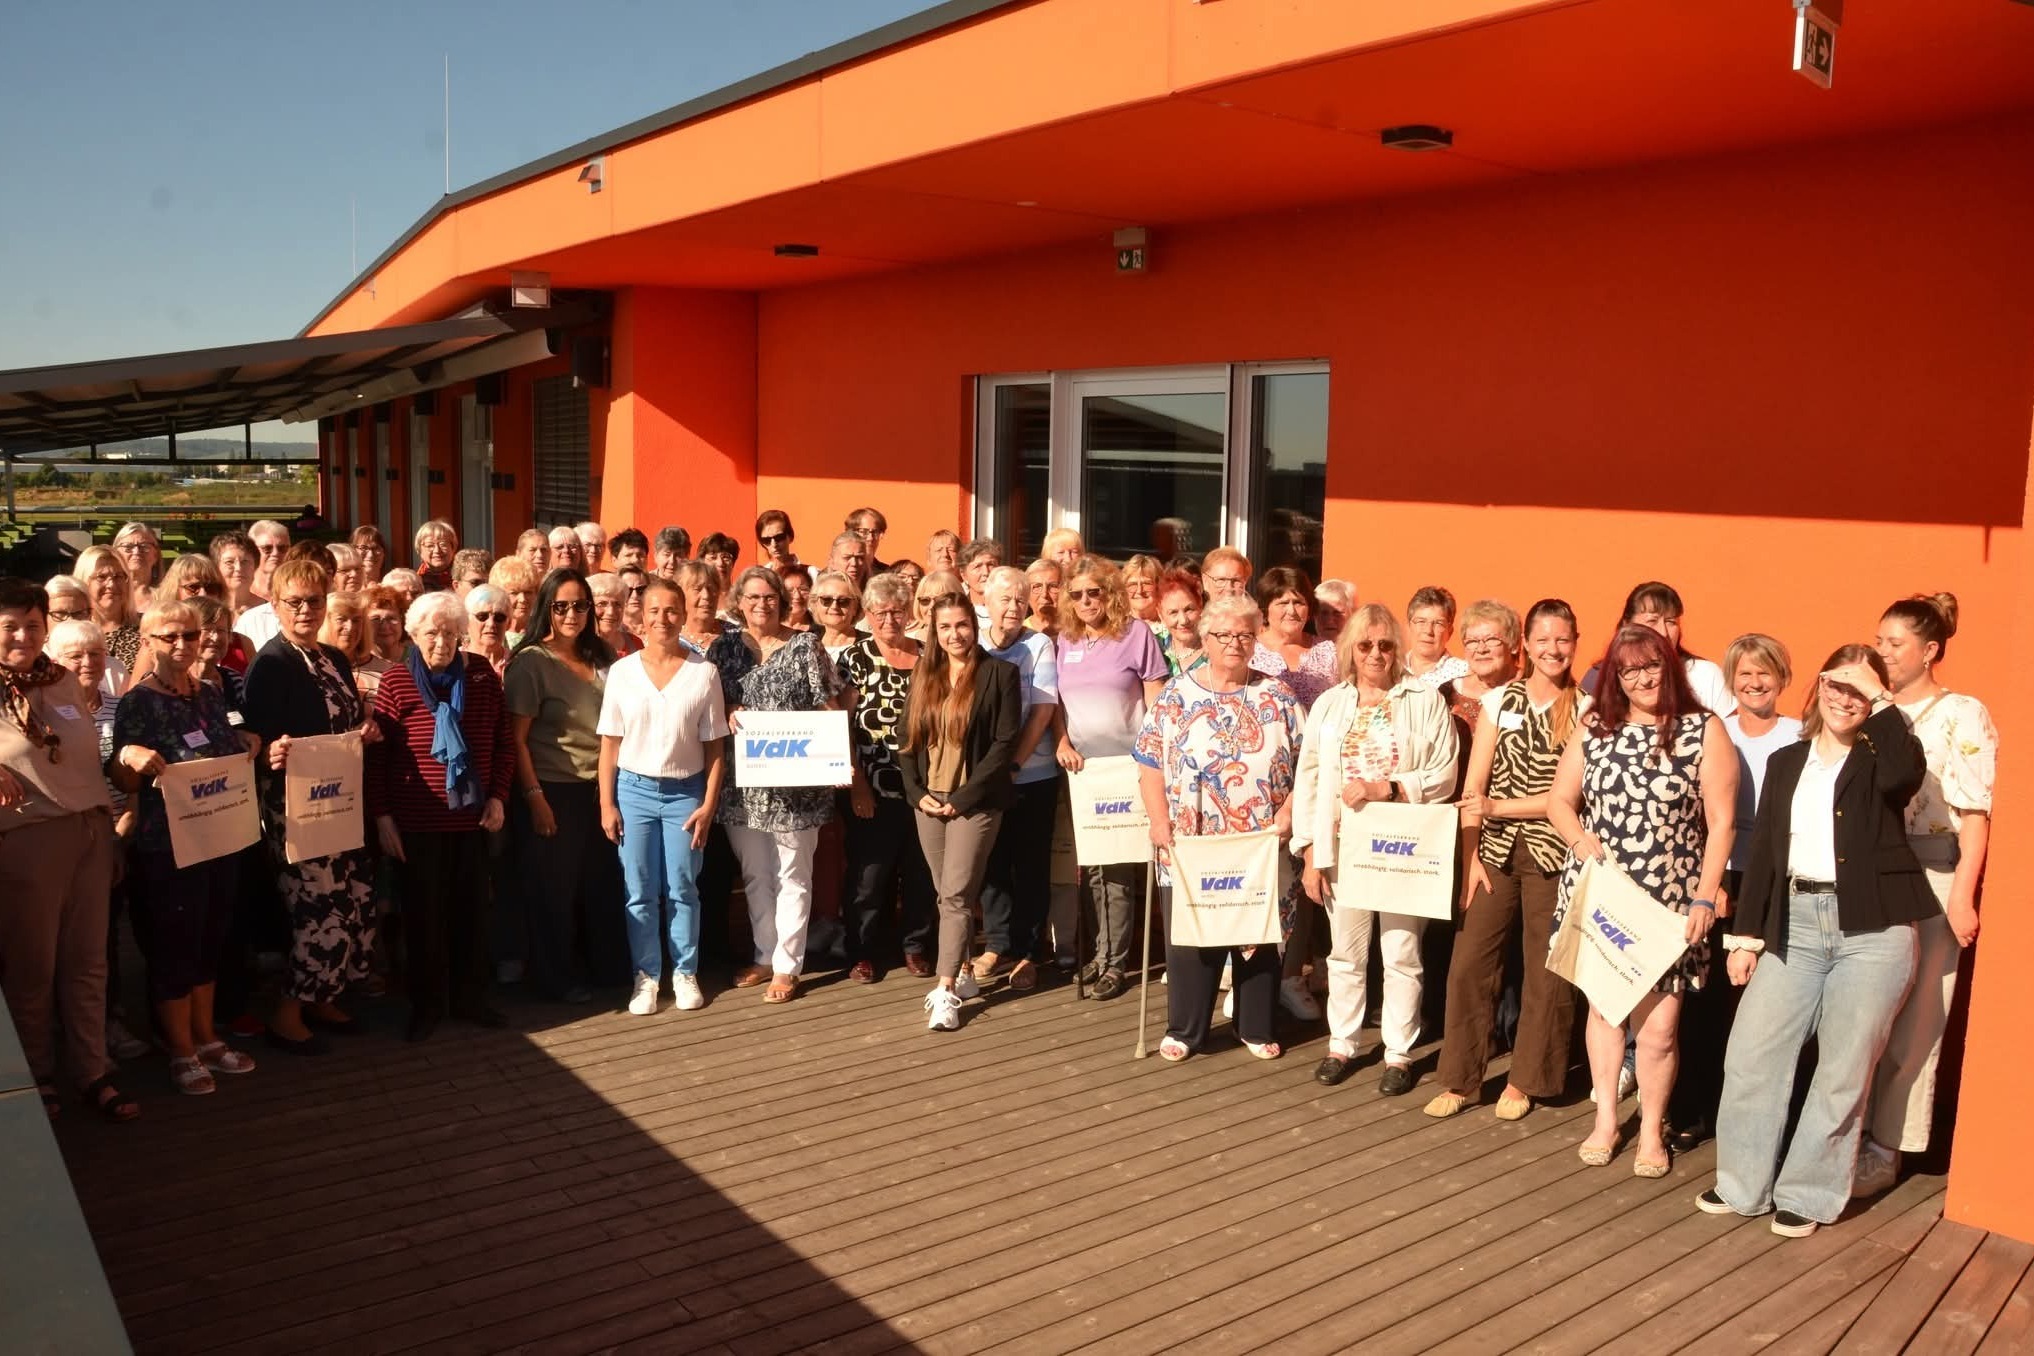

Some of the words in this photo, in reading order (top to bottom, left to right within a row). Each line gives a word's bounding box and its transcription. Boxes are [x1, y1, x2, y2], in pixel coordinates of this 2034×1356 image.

[746, 739, 812, 759] VdK
[191, 776, 229, 799] VdK
[310, 782, 342, 801] VdK
[1095, 801, 1133, 815] VdK
[1372, 839, 1418, 856] VdK
[1201, 876, 1245, 891] VdK
[1592, 908, 1636, 952] VdK
